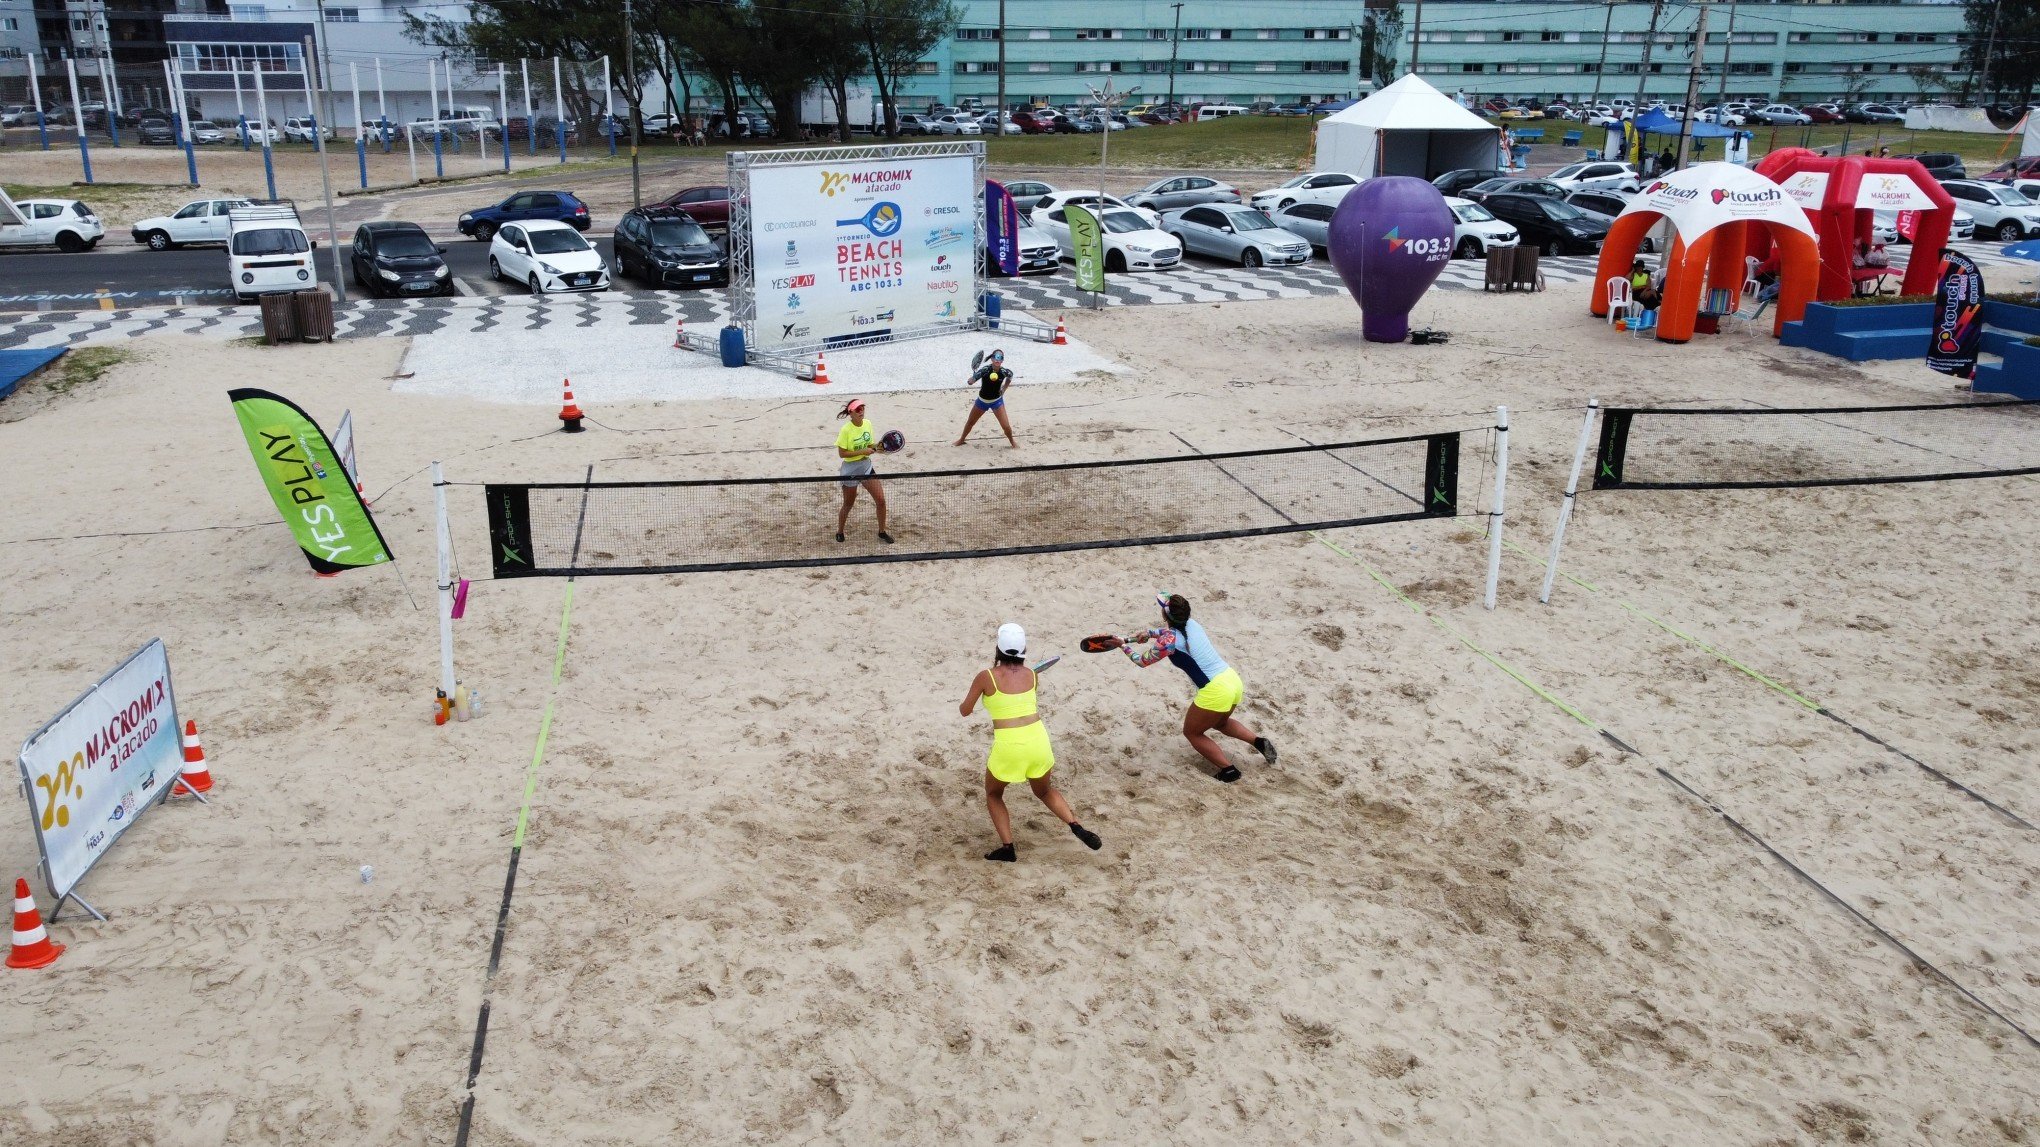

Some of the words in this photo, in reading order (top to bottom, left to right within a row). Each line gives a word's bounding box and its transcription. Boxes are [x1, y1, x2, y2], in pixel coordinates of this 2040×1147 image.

[851, 168, 913, 184] MACROMIX
[865, 182, 901, 194] atacado
[1662, 184, 1698, 199] touch
[1730, 188, 1781, 202] touch
[933, 206, 961, 215] CRESOL
[837, 239, 902, 265] BEACH
[999, 238, 1007, 261] 103.3
[1076, 218, 1094, 287] YESPLAY
[1404, 236, 1451, 255] 103.3
[930, 263, 951, 271] touch
[1426, 254, 1441, 262] ABC
[1943, 253, 1974, 273] beach
[838, 261, 903, 283] TENNIS
[771, 274, 815, 290] YESPLAY
[850, 282, 871, 293] ABC
[875, 278, 903, 290] 103.3
[927, 280, 959, 293] Nautilus
[1958, 274, 1968, 301] SPORTS
[158, 288, 235, 297] UARDA
[1941, 273, 1961, 331] touch
[259, 431, 352, 562] YESPLAY
[504, 492, 512, 518] SHOT
[507, 520, 515, 545] DROP
[85, 676, 166, 770] MACROMIX
[110, 717, 157, 772] atacado
